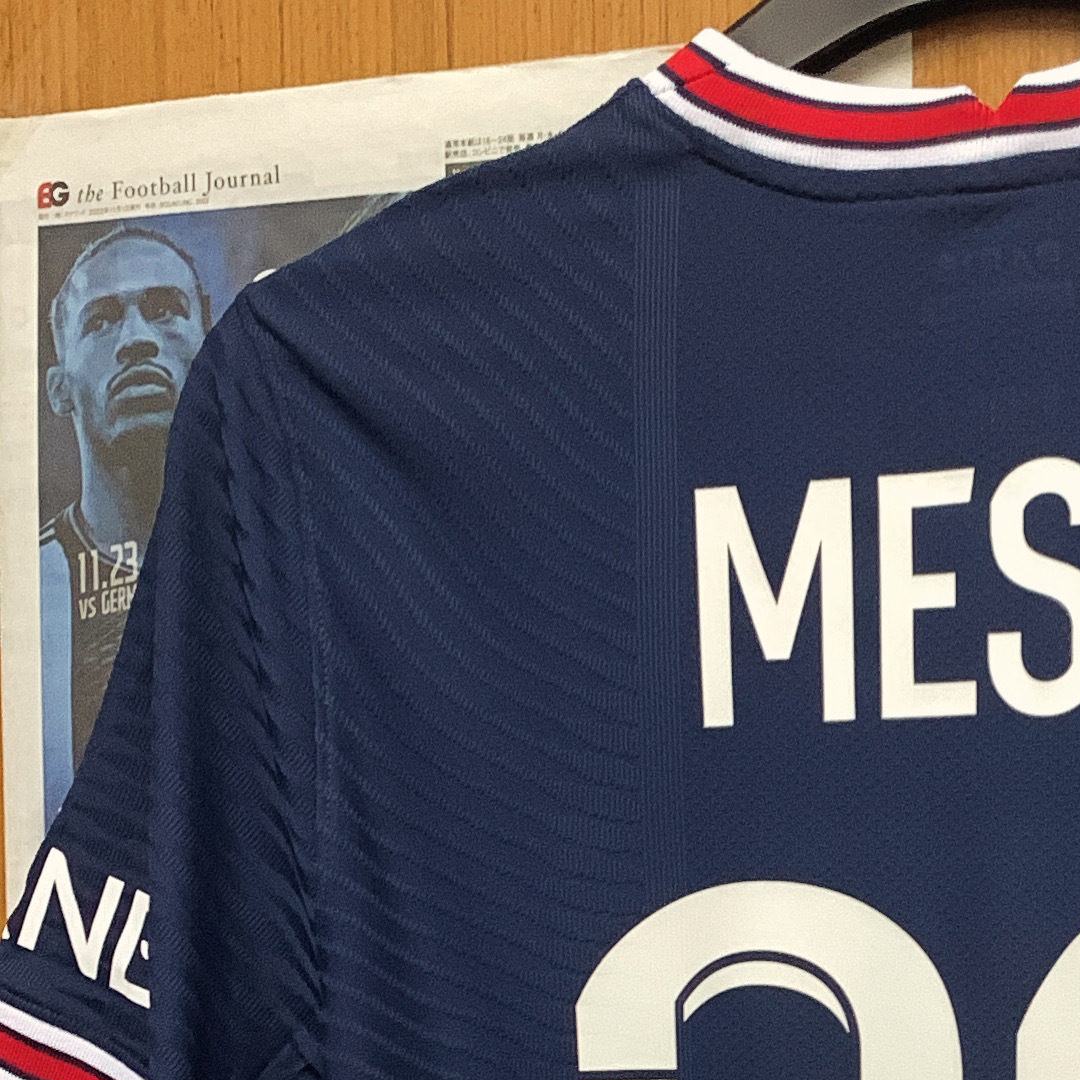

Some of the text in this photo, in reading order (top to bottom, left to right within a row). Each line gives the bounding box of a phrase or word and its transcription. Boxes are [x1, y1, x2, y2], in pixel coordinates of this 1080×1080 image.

[77, 184, 104, 204] the
[112, 173, 197, 200] Football
[203, 164, 281, 196] Journal
[78, 541, 139, 593] 11.23
[79, 596, 96, 619] VS
